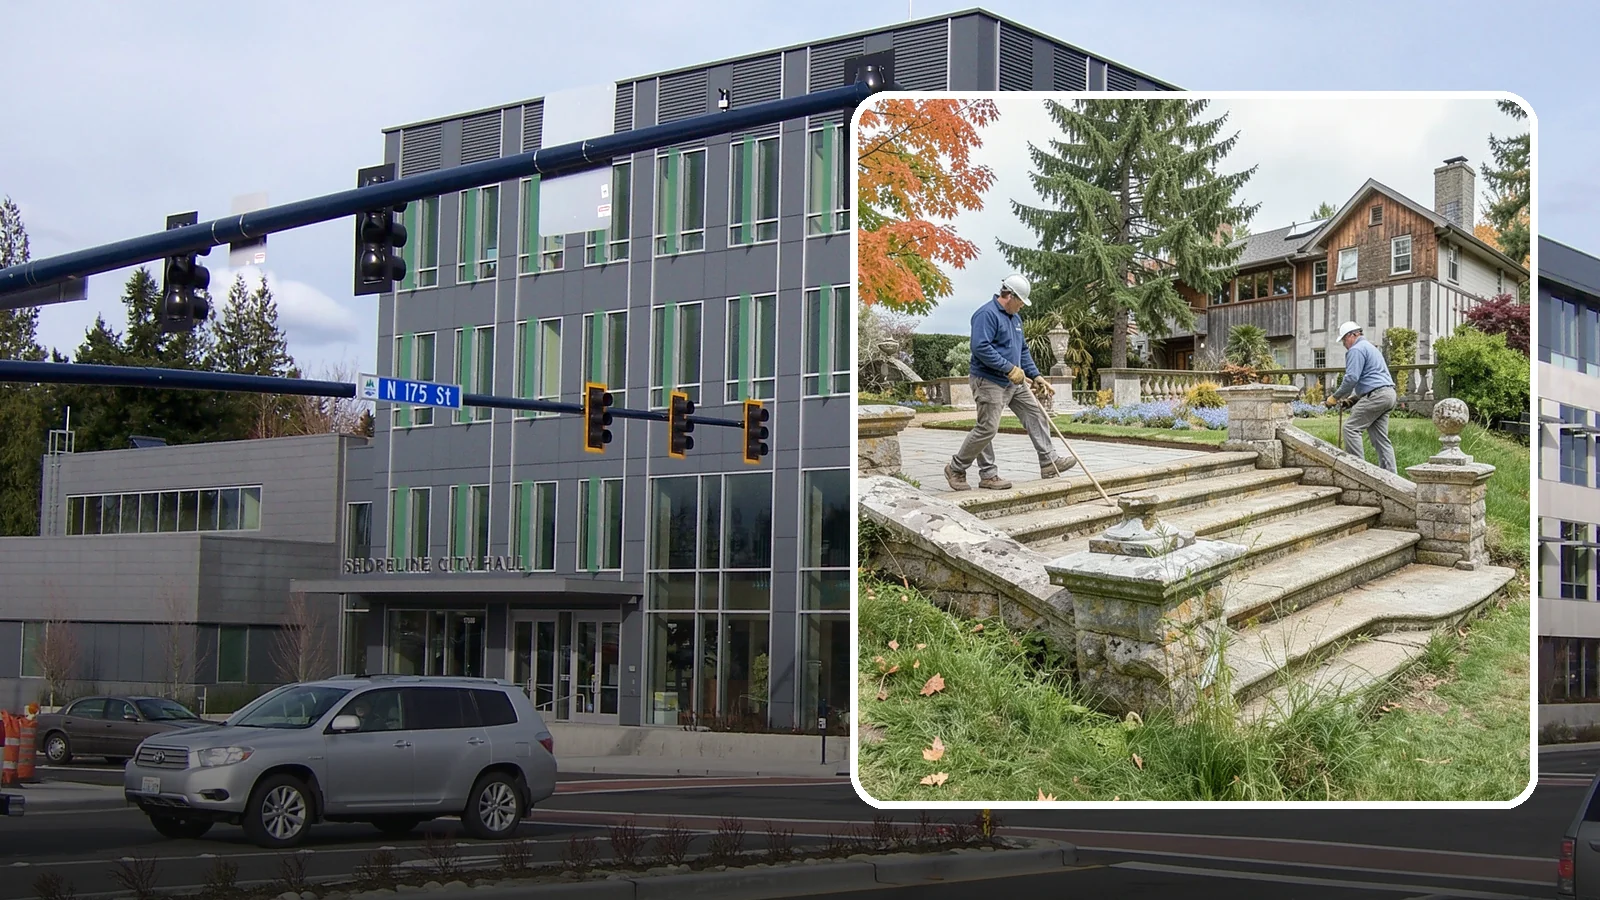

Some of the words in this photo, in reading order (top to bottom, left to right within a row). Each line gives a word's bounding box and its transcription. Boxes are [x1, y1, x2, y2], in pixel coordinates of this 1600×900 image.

[387, 381, 396, 399] N
[405, 383, 427, 403] 175
[436, 387, 451, 406] St
[344, 557, 432, 574] SHORELINE
[438, 556, 476, 572] CITY
[483, 555, 525, 572] HALL
